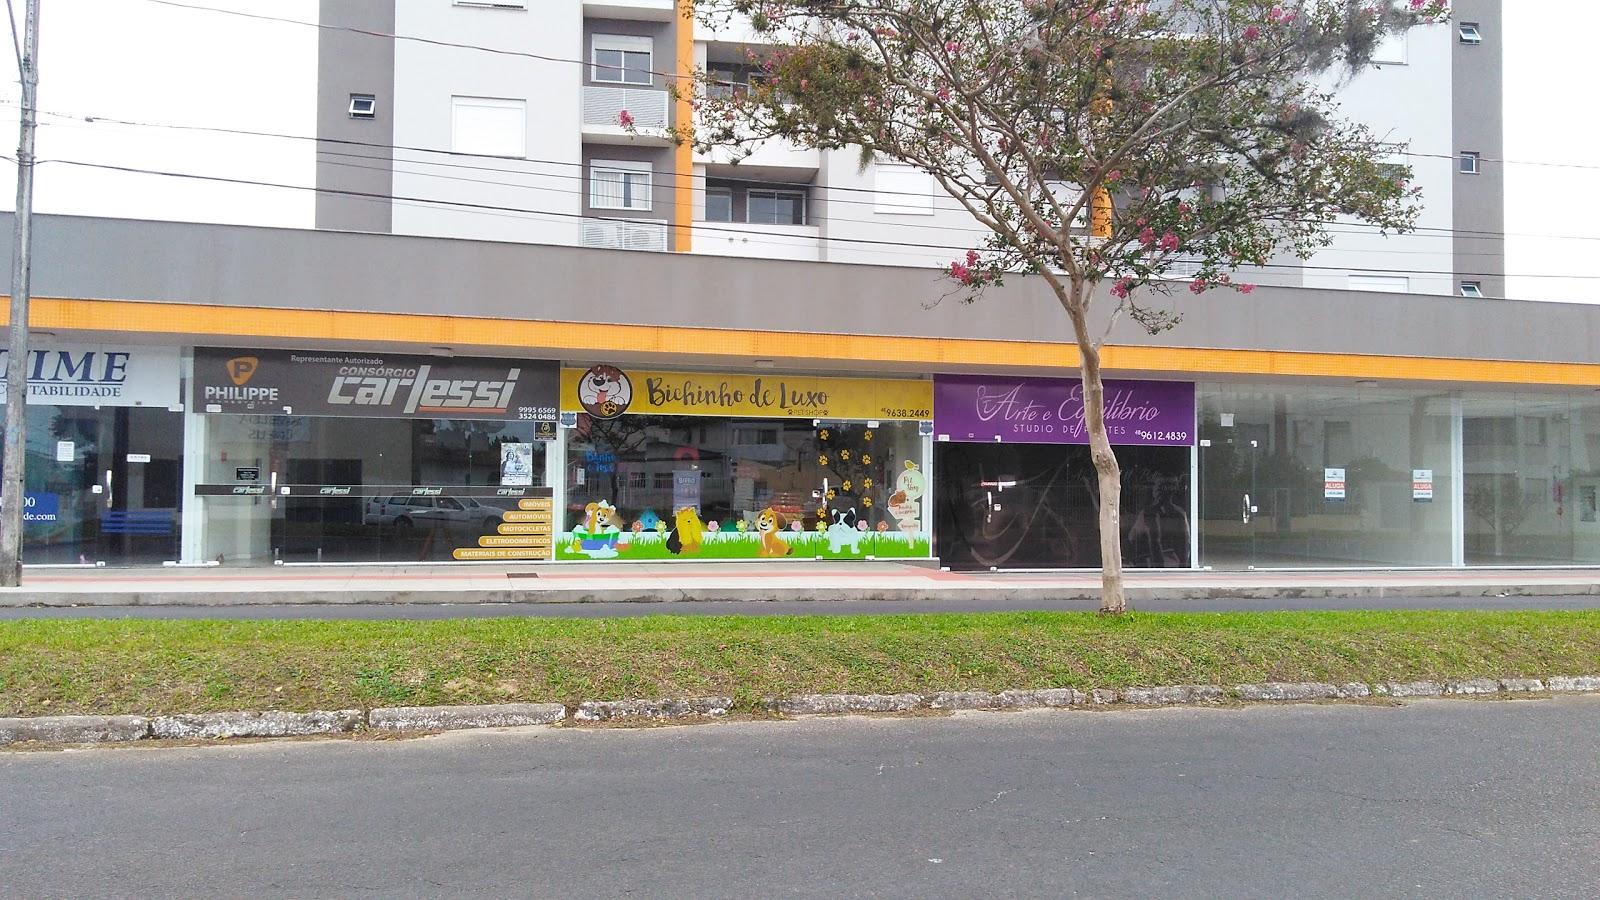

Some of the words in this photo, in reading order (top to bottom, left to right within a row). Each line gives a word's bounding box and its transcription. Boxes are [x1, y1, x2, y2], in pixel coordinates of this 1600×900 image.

[291, 354, 342, 364] Representante
[345, 357, 384, 365] Autorizado
[340, 366, 416, 377] CONSÓRCIO
[205, 386, 279, 401] PHILIPPE
[646, 376, 744, 407] Bichinho
[749, 378, 776, 408] de
[779, 382, 829, 409] Luxo
[886, 409, 930, 418] 9638.2449
[976, 382, 1046, 422] Arte
[1042, 410, 1053, 421] e
[1058, 384, 1160, 438] Eqilíbrio
[1013, 424, 1054, 433] STUDIO
[1141, 432, 1187, 441] 9612.4839
